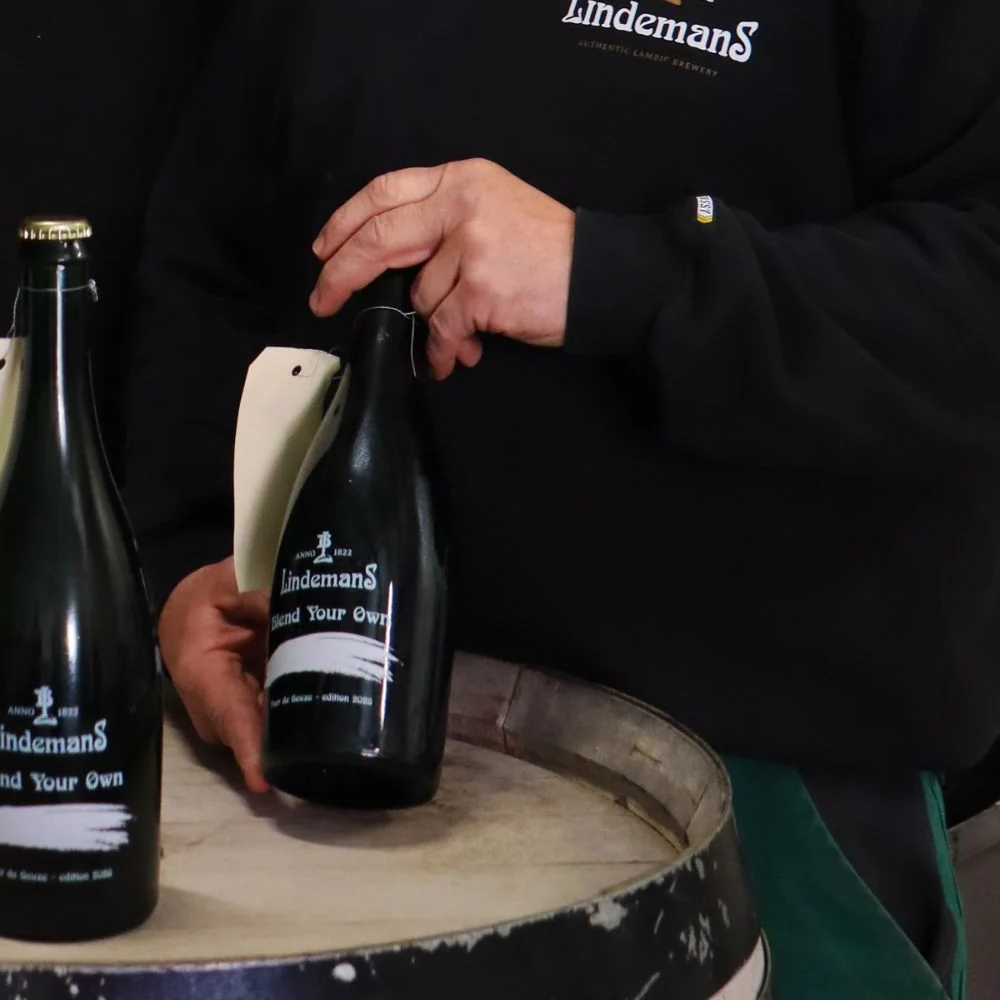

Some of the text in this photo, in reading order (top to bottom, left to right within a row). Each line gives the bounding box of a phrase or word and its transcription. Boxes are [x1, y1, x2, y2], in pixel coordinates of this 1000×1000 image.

[577, 38, 631, 56] AUTHENTIC
[672, 58, 719, 78] BREWERY
[295, 548, 353, 560] ANNO 1822
[306, 605, 346, 622] Your
[321, 692, 350, 703] edition
[7, 705, 35, 717] ANNO
[31, 771, 79, 792] Your
